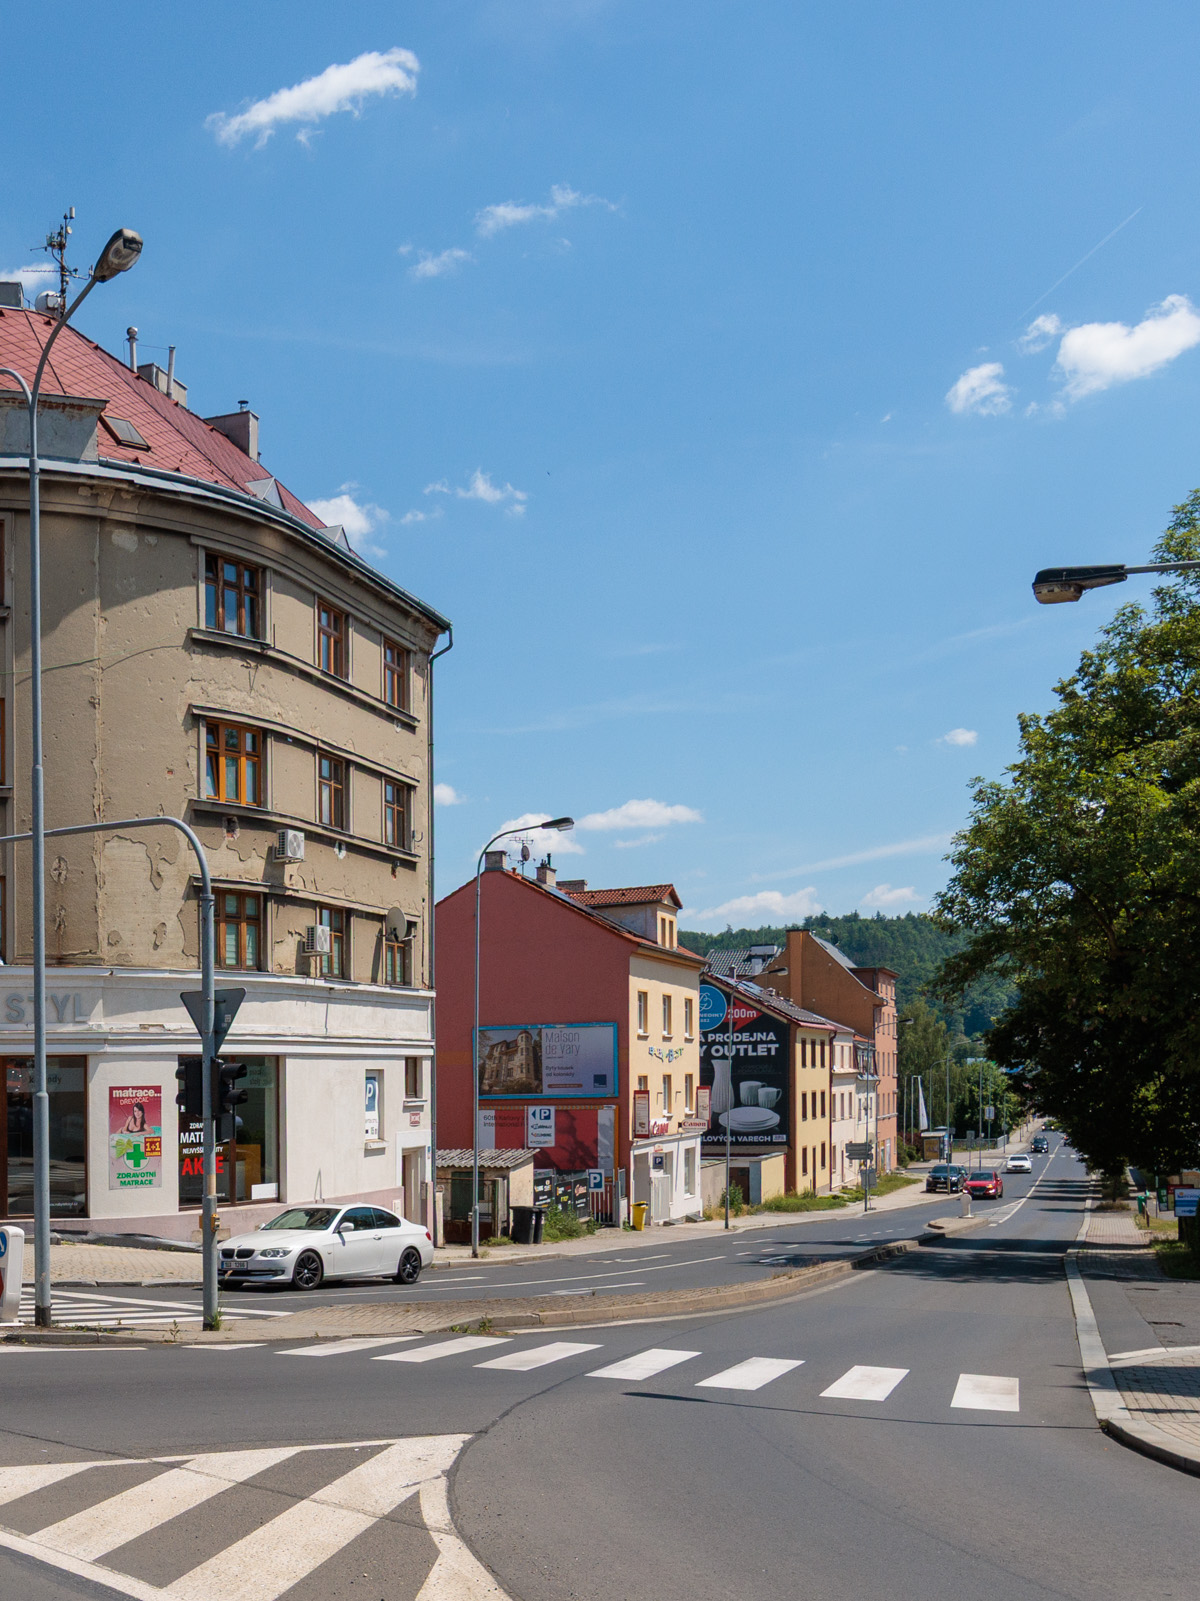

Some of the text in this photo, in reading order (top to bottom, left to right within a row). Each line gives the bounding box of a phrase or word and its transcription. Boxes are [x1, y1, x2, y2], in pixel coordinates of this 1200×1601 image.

[6, 992, 91, 1023] SYL
[728, 1008, 757, 1019] 200m
[545, 1030, 580, 1043] Maison
[708, 1032, 776, 1042] PRODEJNA
[545, 1043, 557, 1055] de
[711, 1043, 779, 1057] OUTLET
[540, 1109, 550, 1120] P
[701, 1133, 736, 1142] LOVÝCH
[145, 1142, 161, 1152] 1+1
[181, 1156, 224, 1176] AKE
[120, 1178, 153, 1186] MATRACE
[589, 1173, 600, 1188] P
